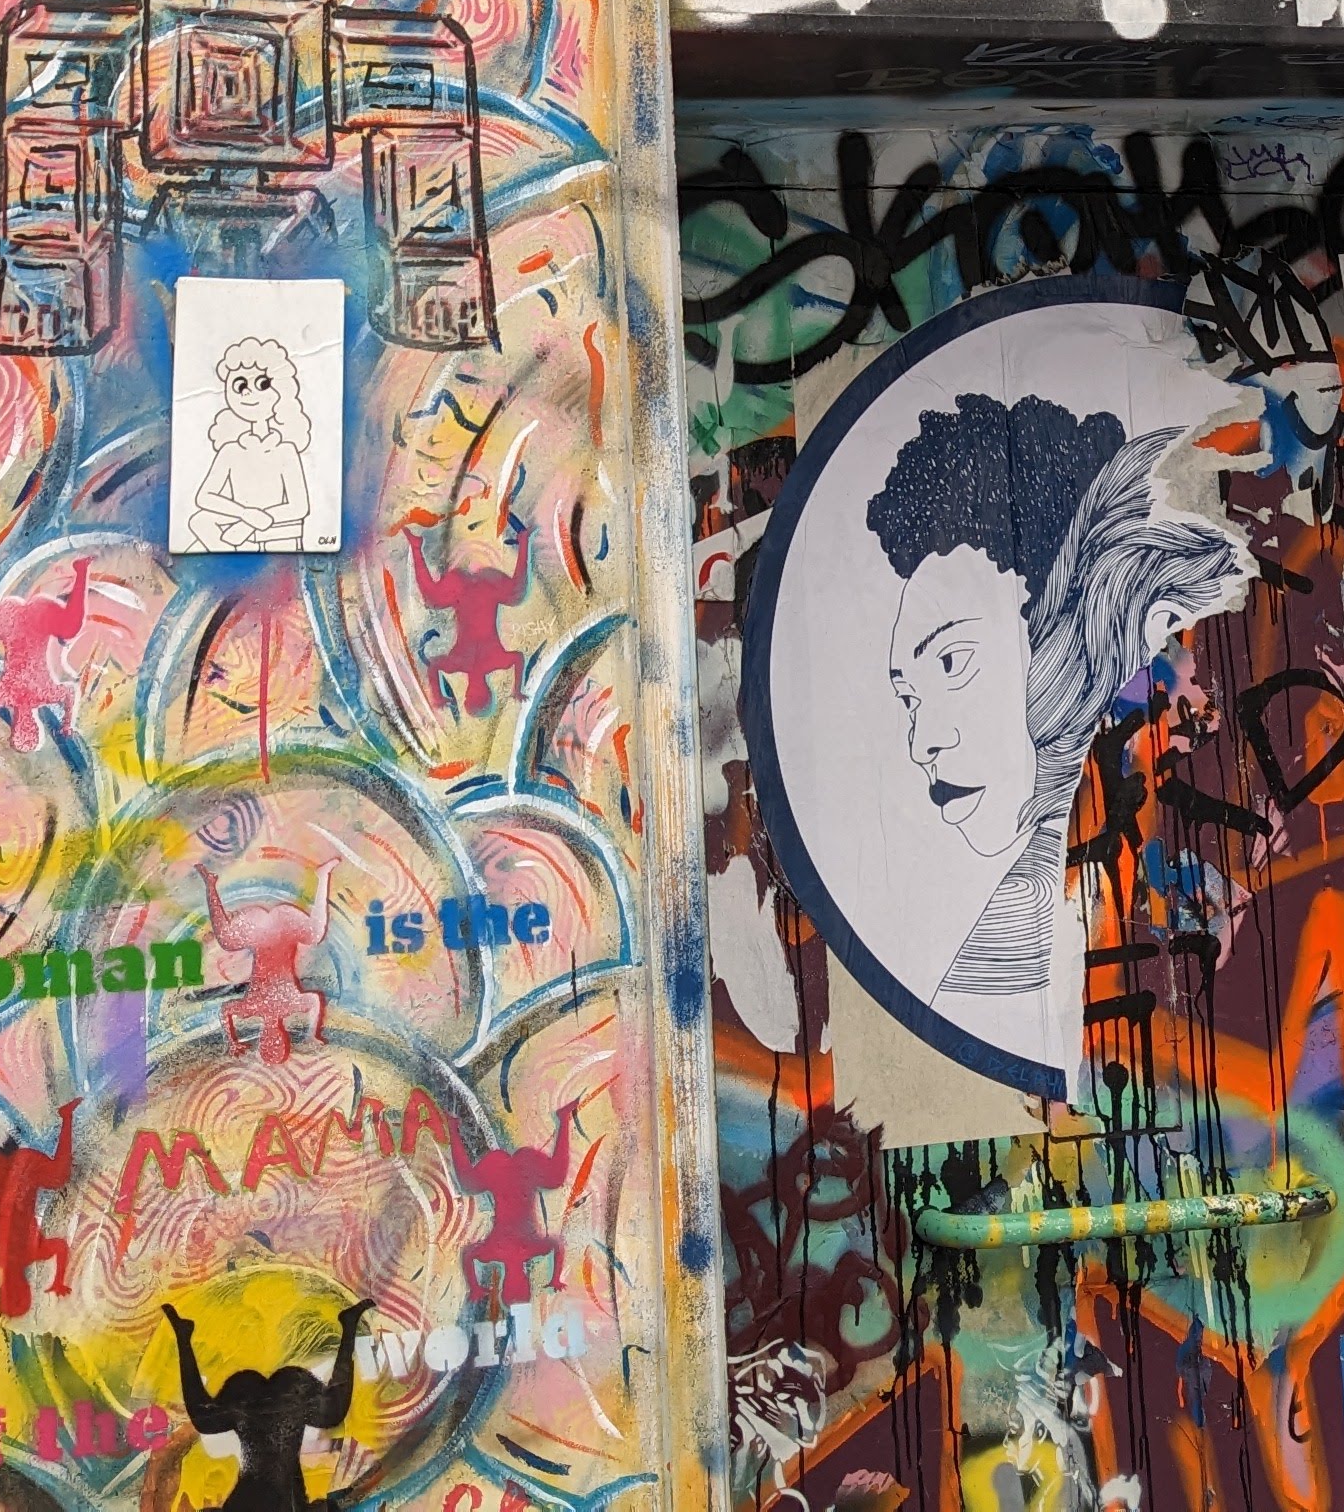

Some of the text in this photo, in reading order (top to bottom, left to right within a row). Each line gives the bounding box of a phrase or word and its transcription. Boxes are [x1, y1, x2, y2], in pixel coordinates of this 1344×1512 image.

[365, 899, 424, 958] is
[438, 896, 550, 948] the
[115, 1088, 452, 1215] MAMA
[33, 1401, 170, 1461] the
[354, 1301, 594, 1379] world
